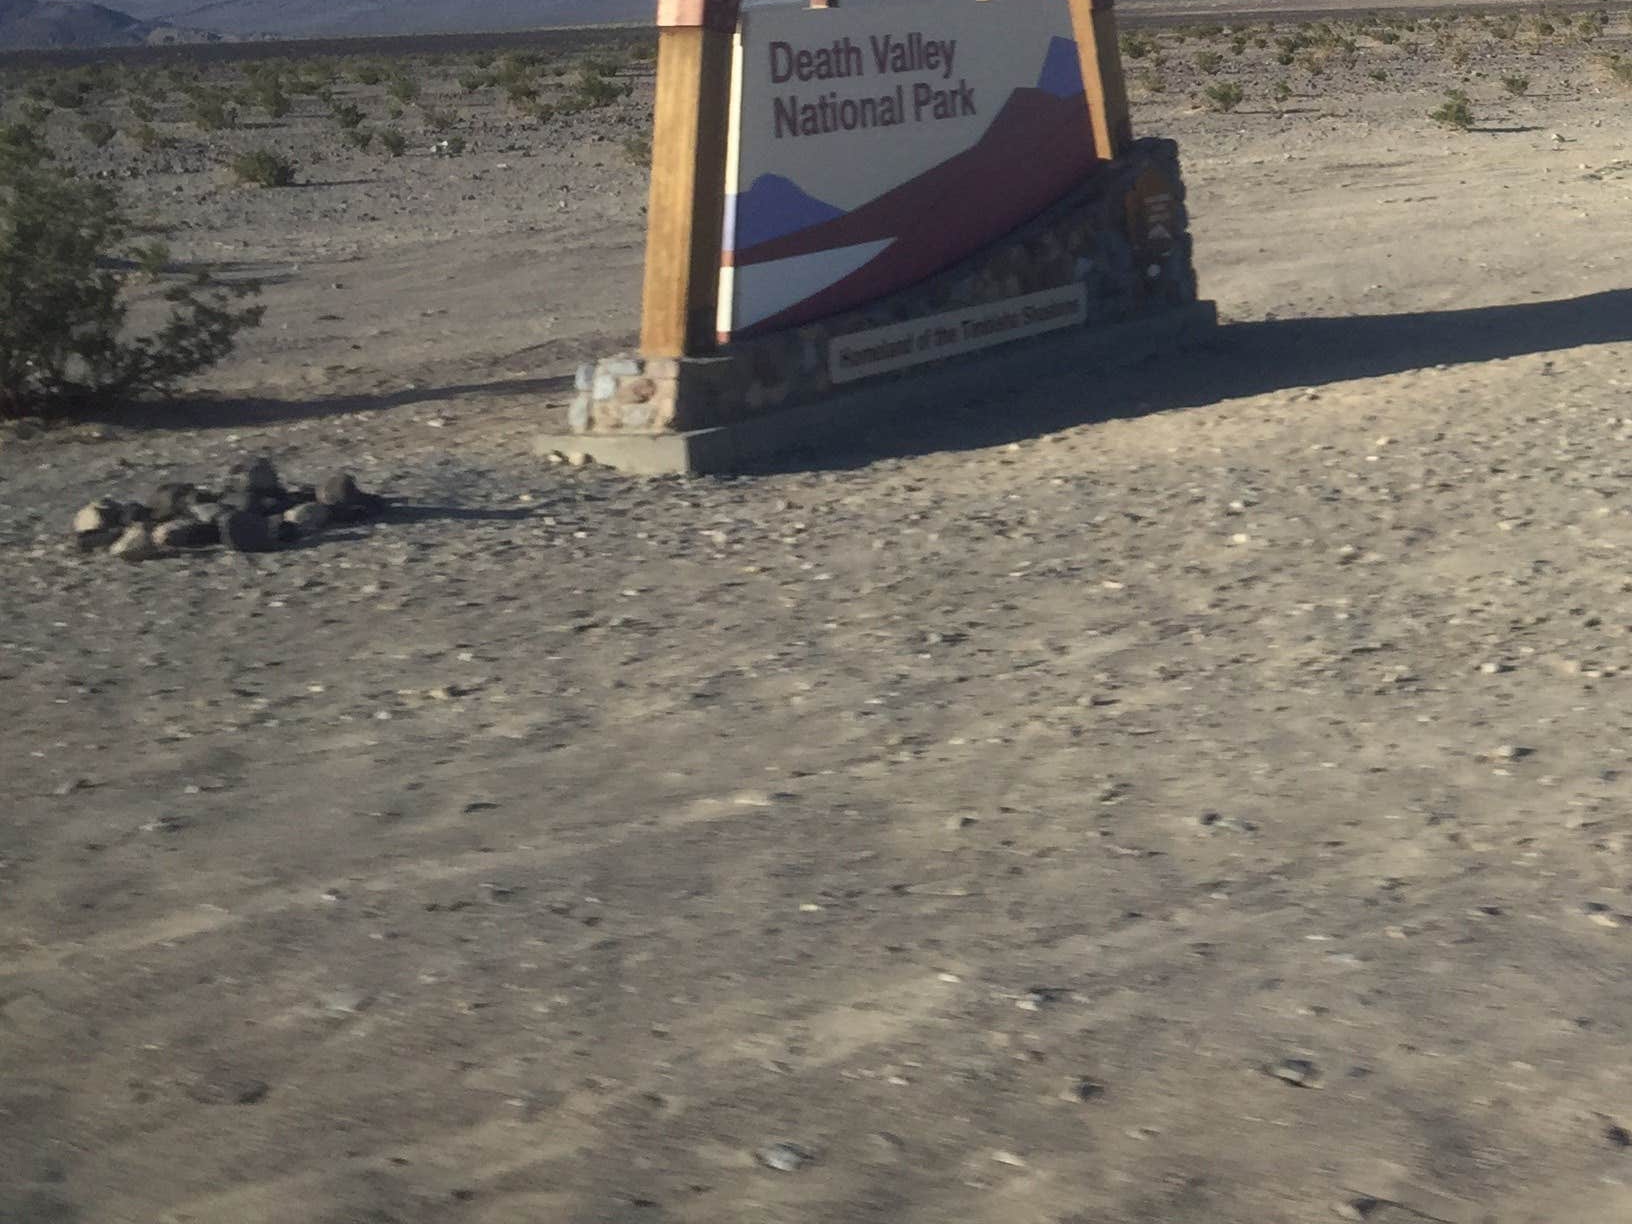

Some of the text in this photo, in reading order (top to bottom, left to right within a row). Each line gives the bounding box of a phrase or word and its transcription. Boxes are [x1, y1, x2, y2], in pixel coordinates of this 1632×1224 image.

[769, 32, 957, 84] Death Valley
[773, 79, 976, 139] National Park
